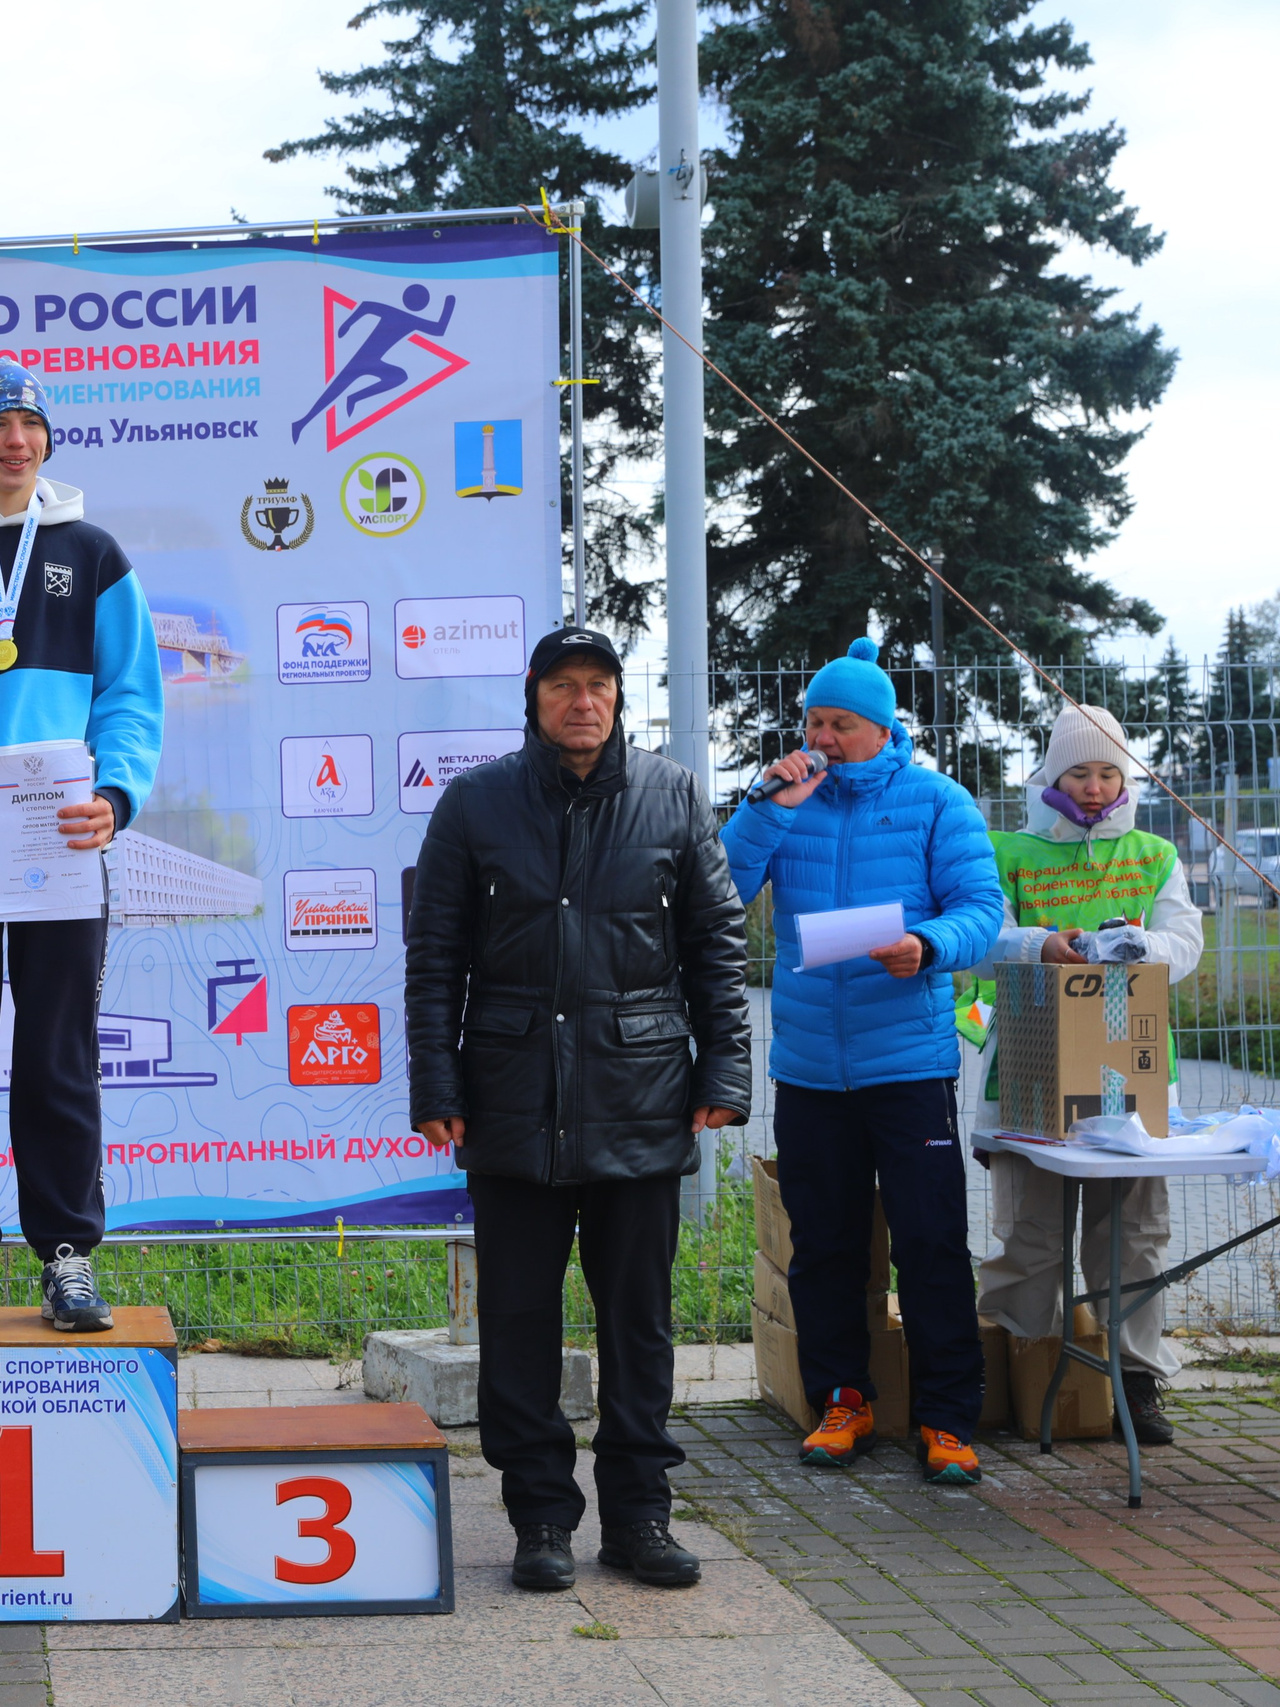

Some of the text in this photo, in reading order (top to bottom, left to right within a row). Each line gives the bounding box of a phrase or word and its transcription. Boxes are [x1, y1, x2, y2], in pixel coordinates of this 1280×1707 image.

[34, 285, 257, 332] РОССИИ
[110, 418, 258, 443] Ульяновск
[257, 496, 297, 505] ТРИУМФ
[359, 514, 408, 524] УЛСПОРТ
[433, 620, 519, 641] azimut
[433, 647, 461, 655] ОТЕЛЬ
[283, 658, 368, 669] ФОНД ПОДДЕРЖКИ
[282, 669, 370, 679] РЕГИОНАЛЬНЫХ ПРОЕКТОВ
[438, 755, 497, 763] МЕТАЛЛО
[11, 791, 64, 804] ДИПЛОМ
[305, 914, 369, 926] ПРЯНИК
[1064, 974, 1139, 997] CDK
[1140, 1057, 1149, 1065] 12
[107, 1134, 336, 1165] ПРОПИТАННЫЙ
[344, 1136, 451, 1162] ДУХОМ
[6, 1360, 139, 1375] СПОРТИВНОГО
[42, 1399, 126, 1414] ОБЛАСТИ
[274, 1476, 357, 1584] 3
